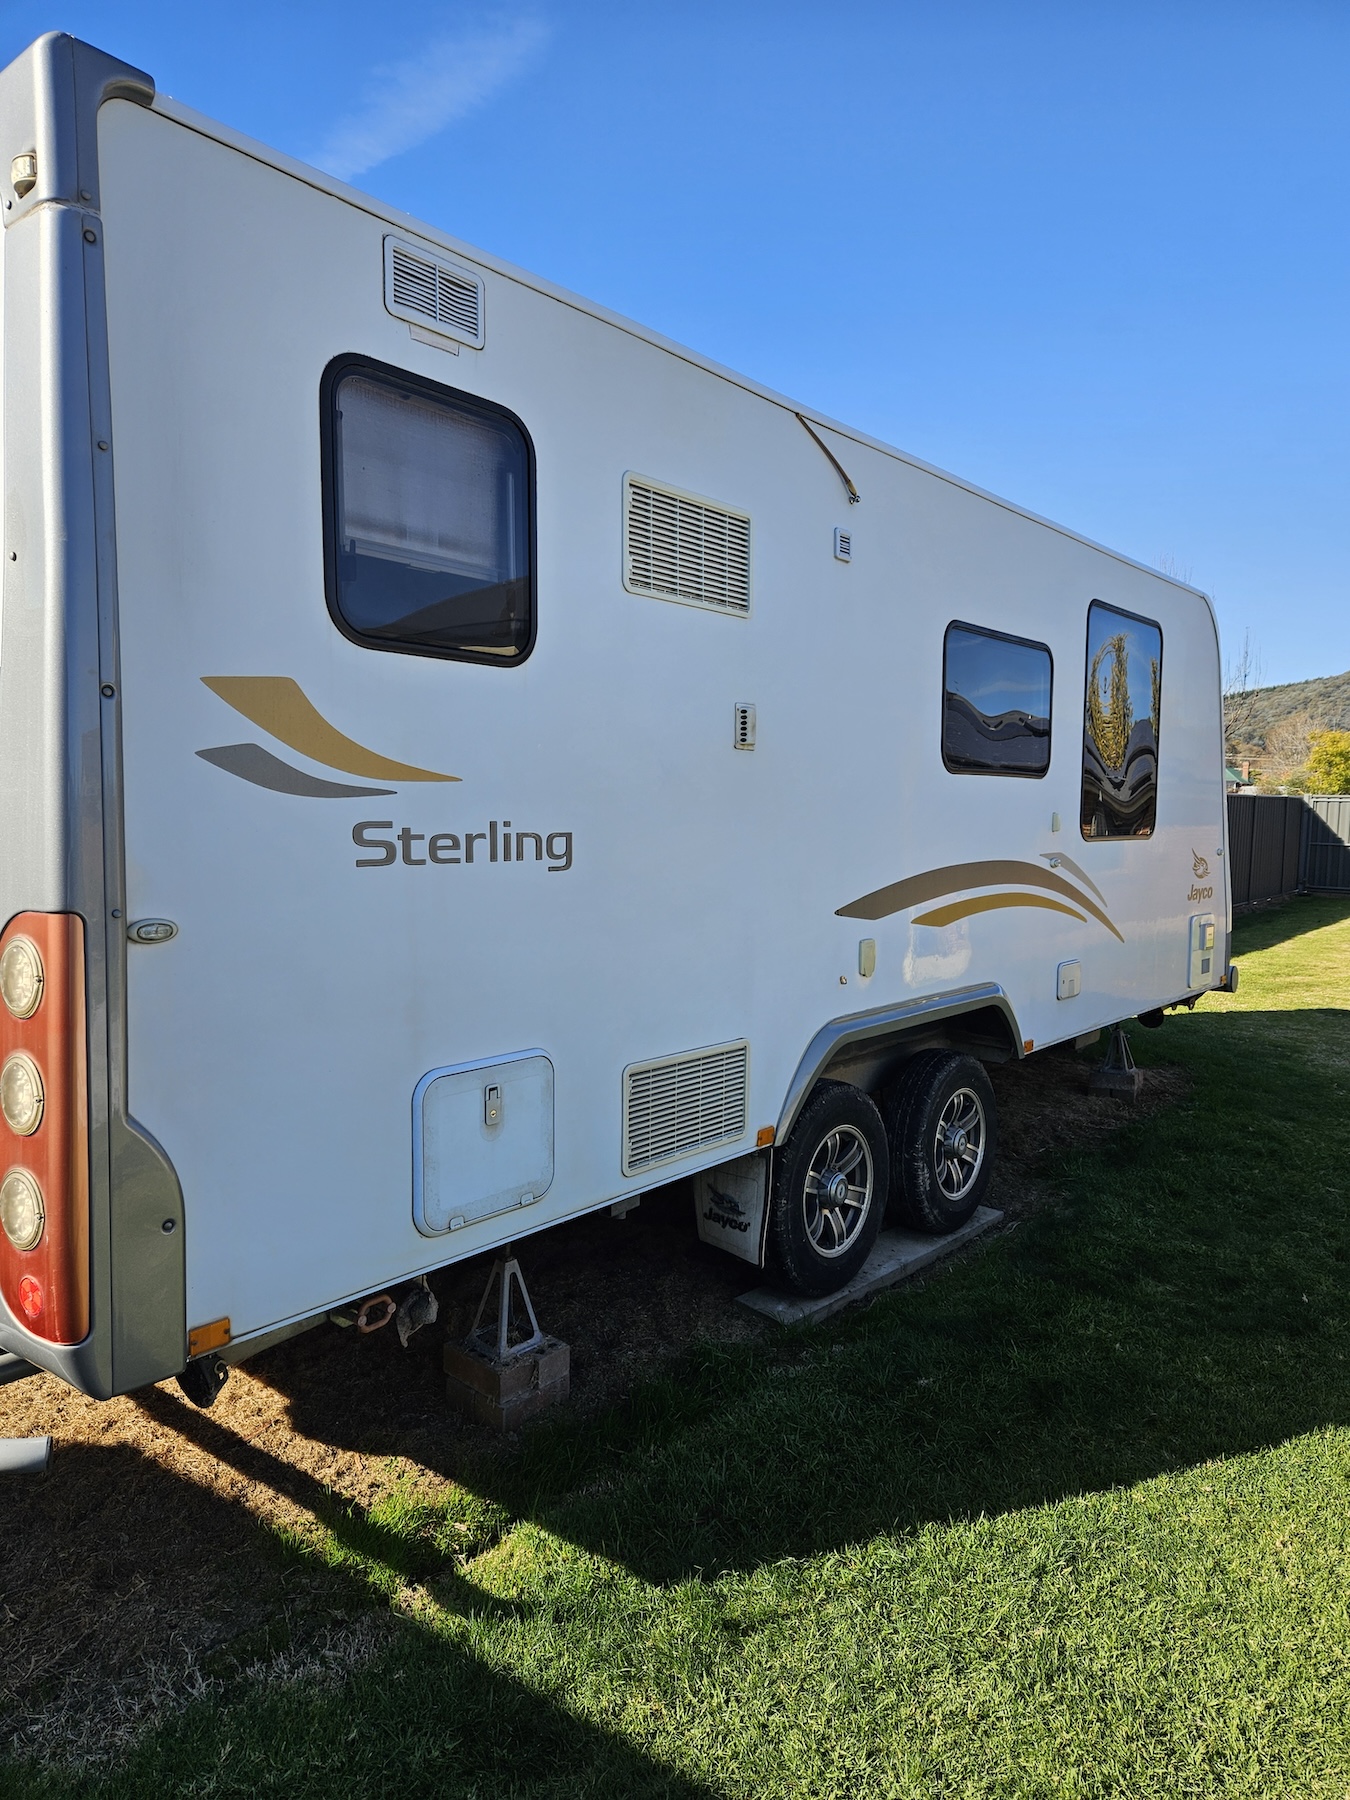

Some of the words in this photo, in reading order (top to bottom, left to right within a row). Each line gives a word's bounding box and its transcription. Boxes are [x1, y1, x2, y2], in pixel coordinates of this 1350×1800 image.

[352, 820, 573, 872] Sterling
[1187, 884, 1213, 903] Jayco
[703, 1207, 749, 1232] Jayco
